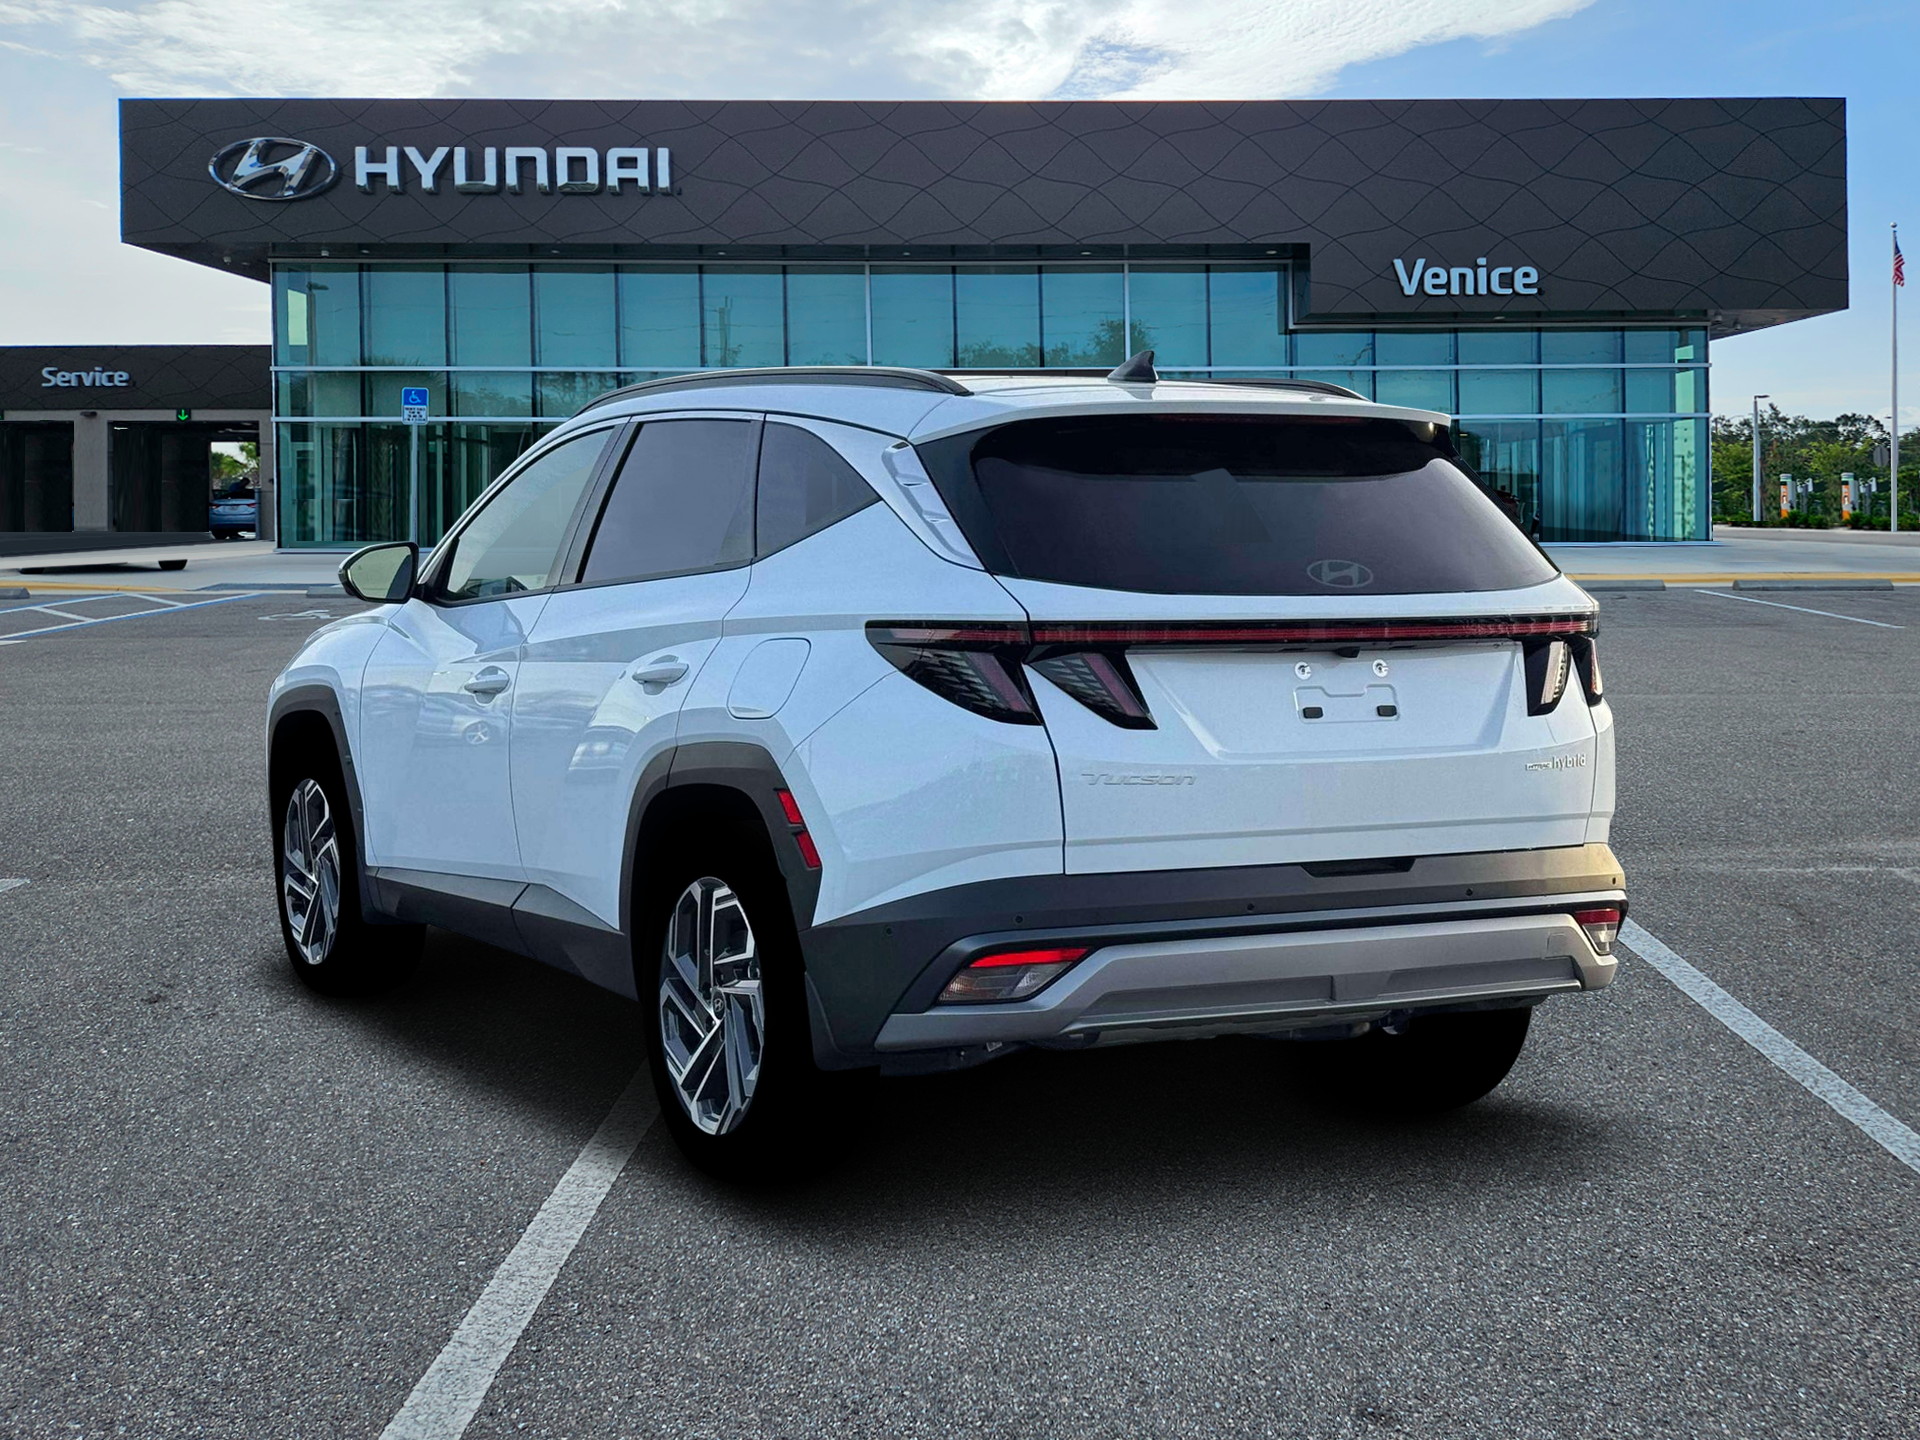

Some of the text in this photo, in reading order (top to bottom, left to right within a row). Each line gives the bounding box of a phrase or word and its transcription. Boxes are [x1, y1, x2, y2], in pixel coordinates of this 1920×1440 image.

[354, 146, 672, 195] HYUNDAI
[1393, 257, 1539, 296] Venice
[41, 366, 130, 387] Service
[1552, 754, 1586, 771] hybrid
